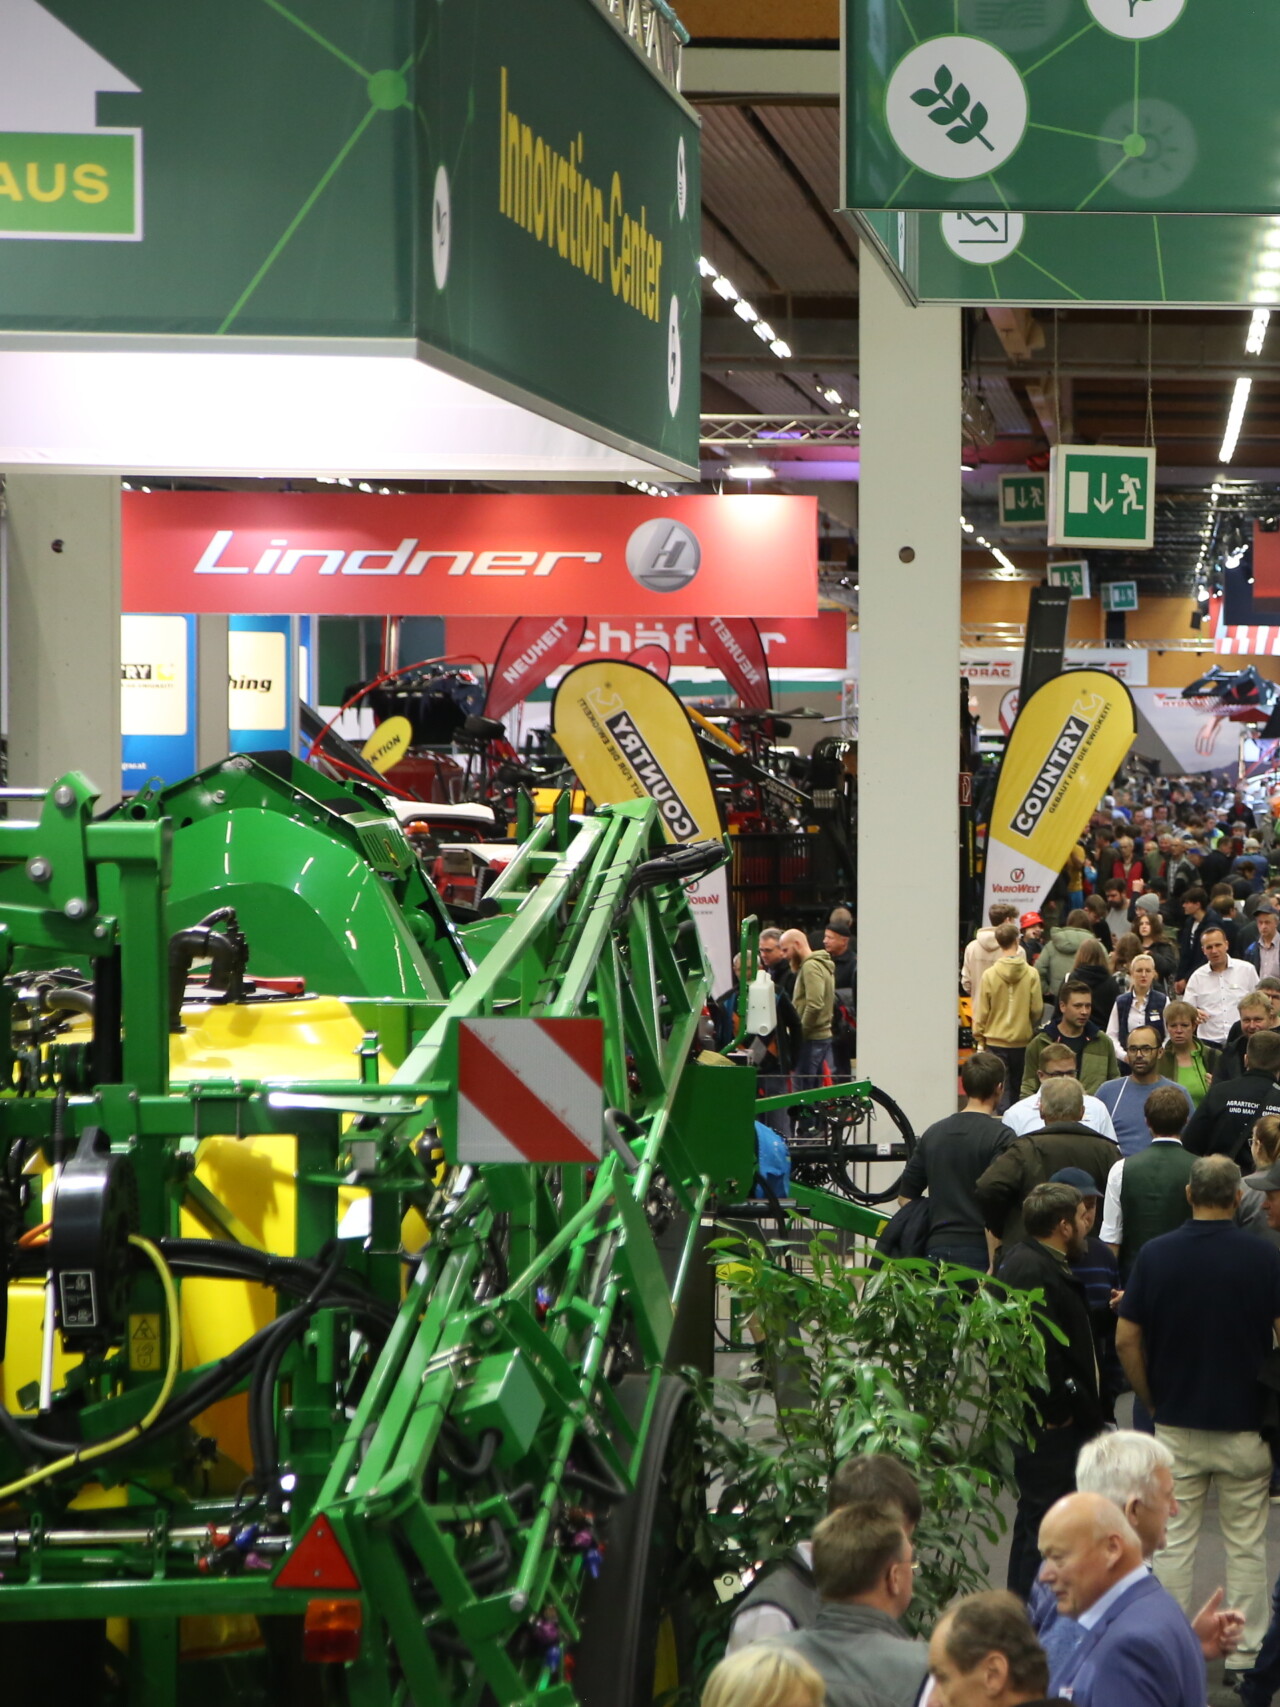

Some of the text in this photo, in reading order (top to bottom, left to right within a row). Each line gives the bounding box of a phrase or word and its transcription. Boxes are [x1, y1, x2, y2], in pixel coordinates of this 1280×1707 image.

[500, 66, 662, 323] Innovation-Center
[193, 530, 603, 577] Lindner
[503, 617, 570, 685] NEUHEIT
[1016, 720, 1083, 832] COUNTRY
[1048, 781, 1070, 814] GEBAUT
[1077, 746, 1089, 763] DIE
